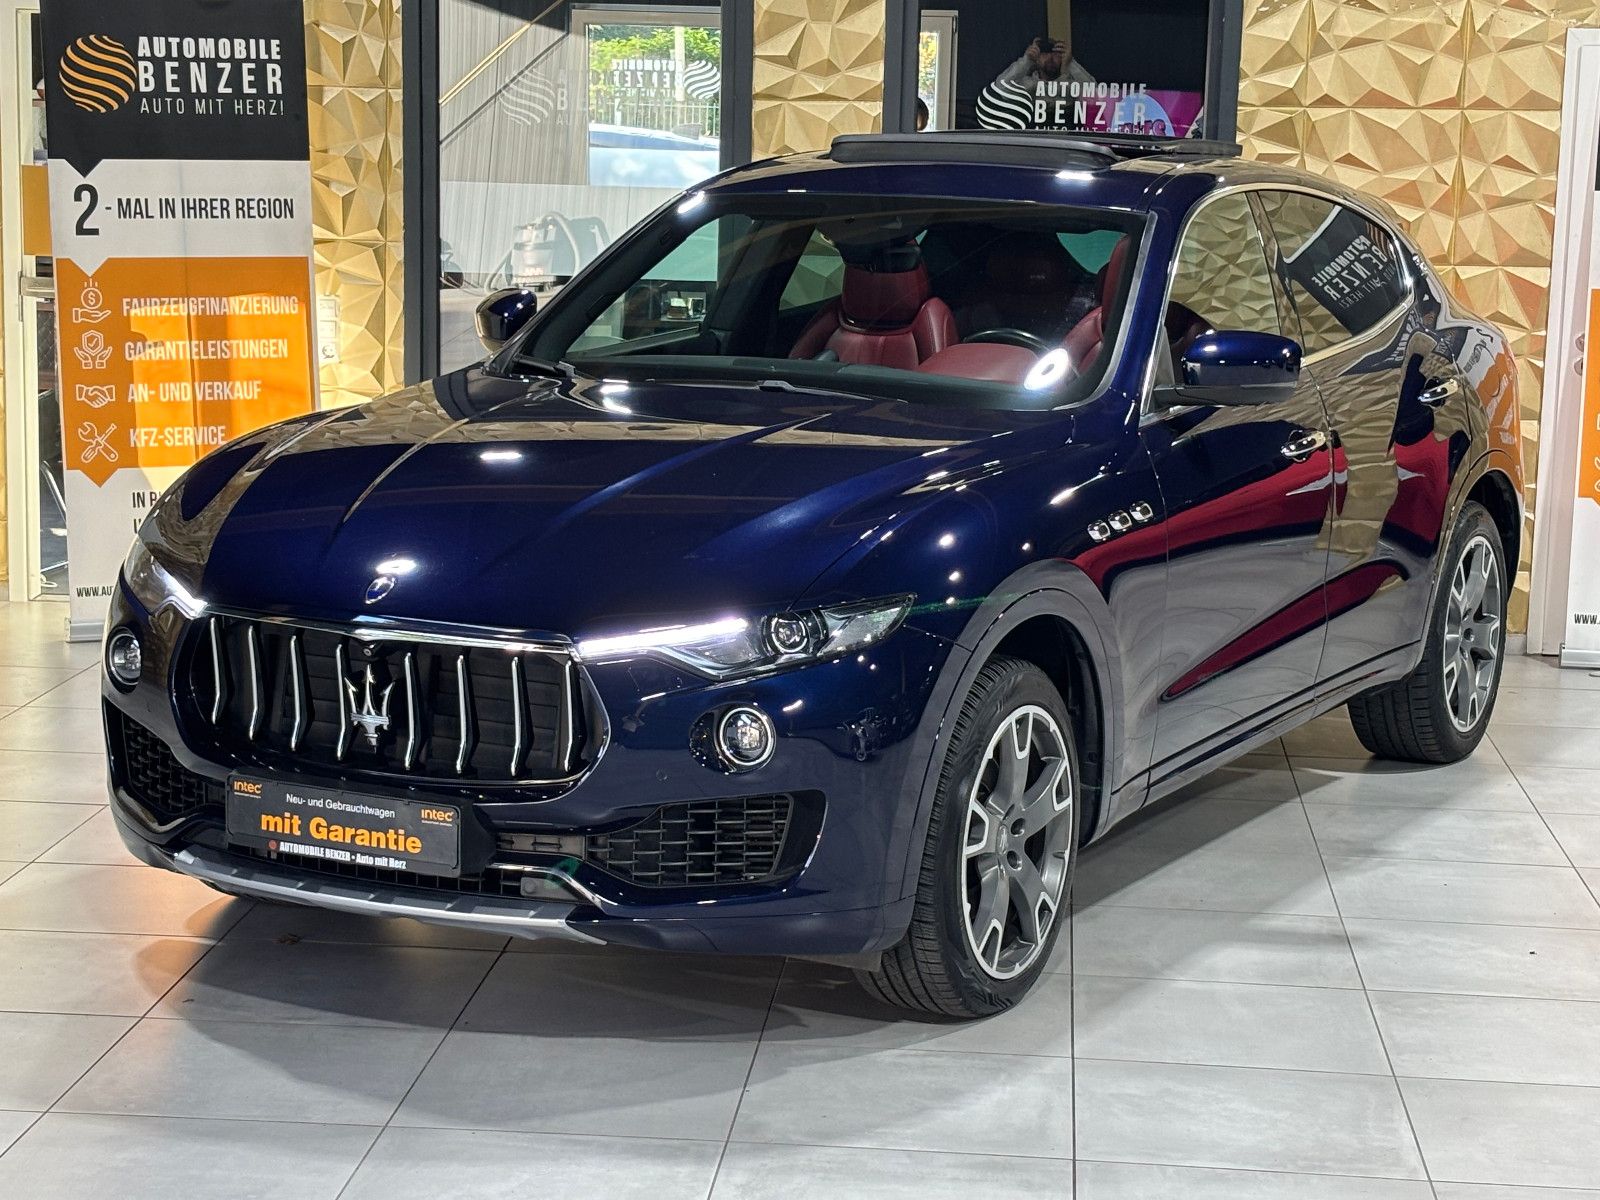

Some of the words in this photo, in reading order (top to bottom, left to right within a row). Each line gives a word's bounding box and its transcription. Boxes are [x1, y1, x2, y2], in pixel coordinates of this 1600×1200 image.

[138, 36, 281, 59] AUTOMOBILE
[138, 61, 283, 94] BENZER
[1036, 81, 1147, 98] AUTOMOBILE
[140, 98, 185, 115] AUTO
[195, 98, 224, 115] MIT
[234, 99, 285, 116] HERZ!
[1034, 100, 1146, 125] BENZER
[117, 198, 155, 219] MAL
[159, 198, 176, 219] IN
[181, 198, 231, 219] IHRER
[236, 198, 295, 219] REGION
[122, 296, 299, 317] FAHRZEUGFINANZIERUNG
[124, 339, 288, 361] GARANTIELEISTUNGEN
[128, 384, 155, 403] AN-
[159, 382, 191, 402] UND
[195, 380, 262, 401] VERKAUF
[130, 426, 226, 447] KFZ-SERVICE
[132, 491, 145, 508] IN
[1574, 614, 1600, 624] WWW.
[286, 793, 306, 805] Neu-
[308, 798, 323, 808] und
[325, 799, 396, 819] Gebrauchtwagen
[261, 811, 301, 836] mit
[309, 816, 422, 854] Garantie
[279, 841, 325, 857] AUTOMOBILE
[325, 848, 351, 861] BENZER
[355, 853, 374, 866] Auto
[374, 857, 388, 867] mit
